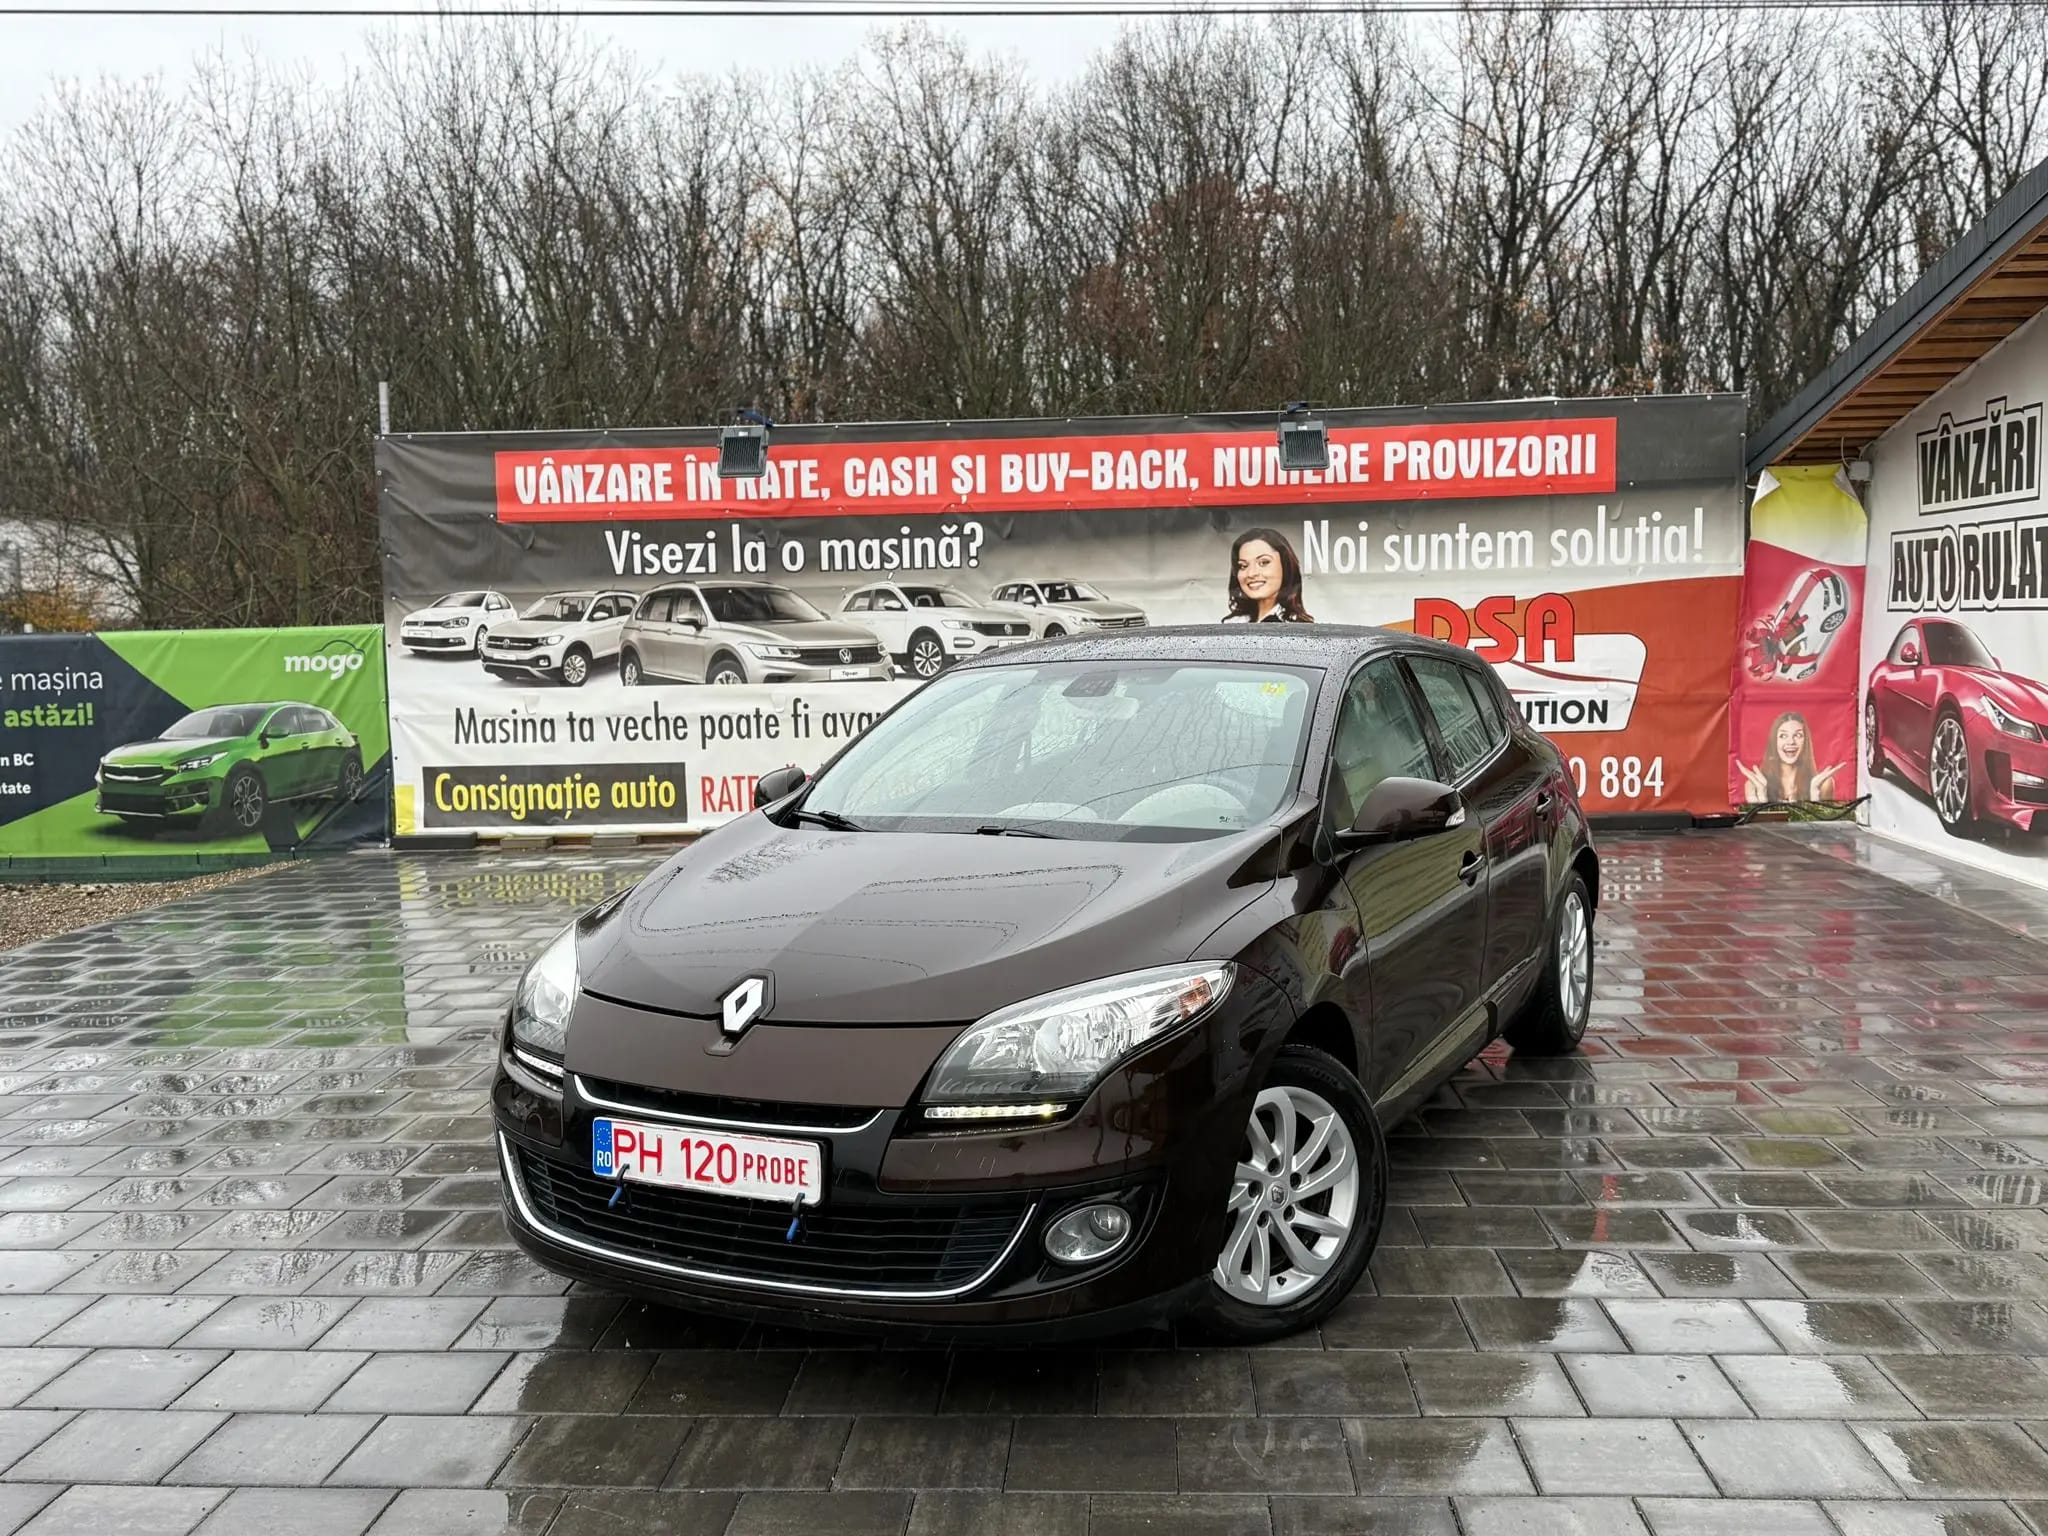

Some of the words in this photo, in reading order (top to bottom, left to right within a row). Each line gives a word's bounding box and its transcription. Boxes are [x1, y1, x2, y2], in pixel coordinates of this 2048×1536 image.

[514, 456, 673, 505] VÂNZARE
[684, 454, 721, 501] ÎN
[843, 454, 937, 500] CASH
[951, 454, 986, 503] ȘI
[1001, 448, 1199, 493] BUY-BACK,
[1383, 433, 1597, 482] PROVIZORII
[1920, 408, 2037, 506] VÂNZĂRI
[604, 529, 718, 577] Visezi
[731, 523, 767, 573] la
[783, 538, 806, 573] o
[820, 520, 985, 580] mașină?
[1303, 519, 1369, 573] Noi
[1383, 522, 1533, 570] suntem
[1550, 504, 1704, 576] soluția!
[1414, 593, 1575, 664] DSA
[11, 666, 104, 697] mașina
[283, 653, 365, 680] mogo
[4, 702, 94, 728] astăzi!
[455, 706, 555, 745] Masina
[566, 706, 595, 742] ta
[607, 700, 689, 741] veche
[700, 704, 781, 750] poate
[791, 697, 811, 738] fi
[822, 712, 884, 738] ava
[13, 752, 35, 767] BC
[1600, 755, 1665, 799] 884
[0, 781, 32, 795] tate
[434, 772, 601, 822] Consignație
[610, 779, 676, 809] auto
[597, 1149, 612, 1169] RO
[613, 1127, 663, 1176] PH
[680, 1138, 738, 1184] 120
[743, 1152, 809, 1188] PROBE
